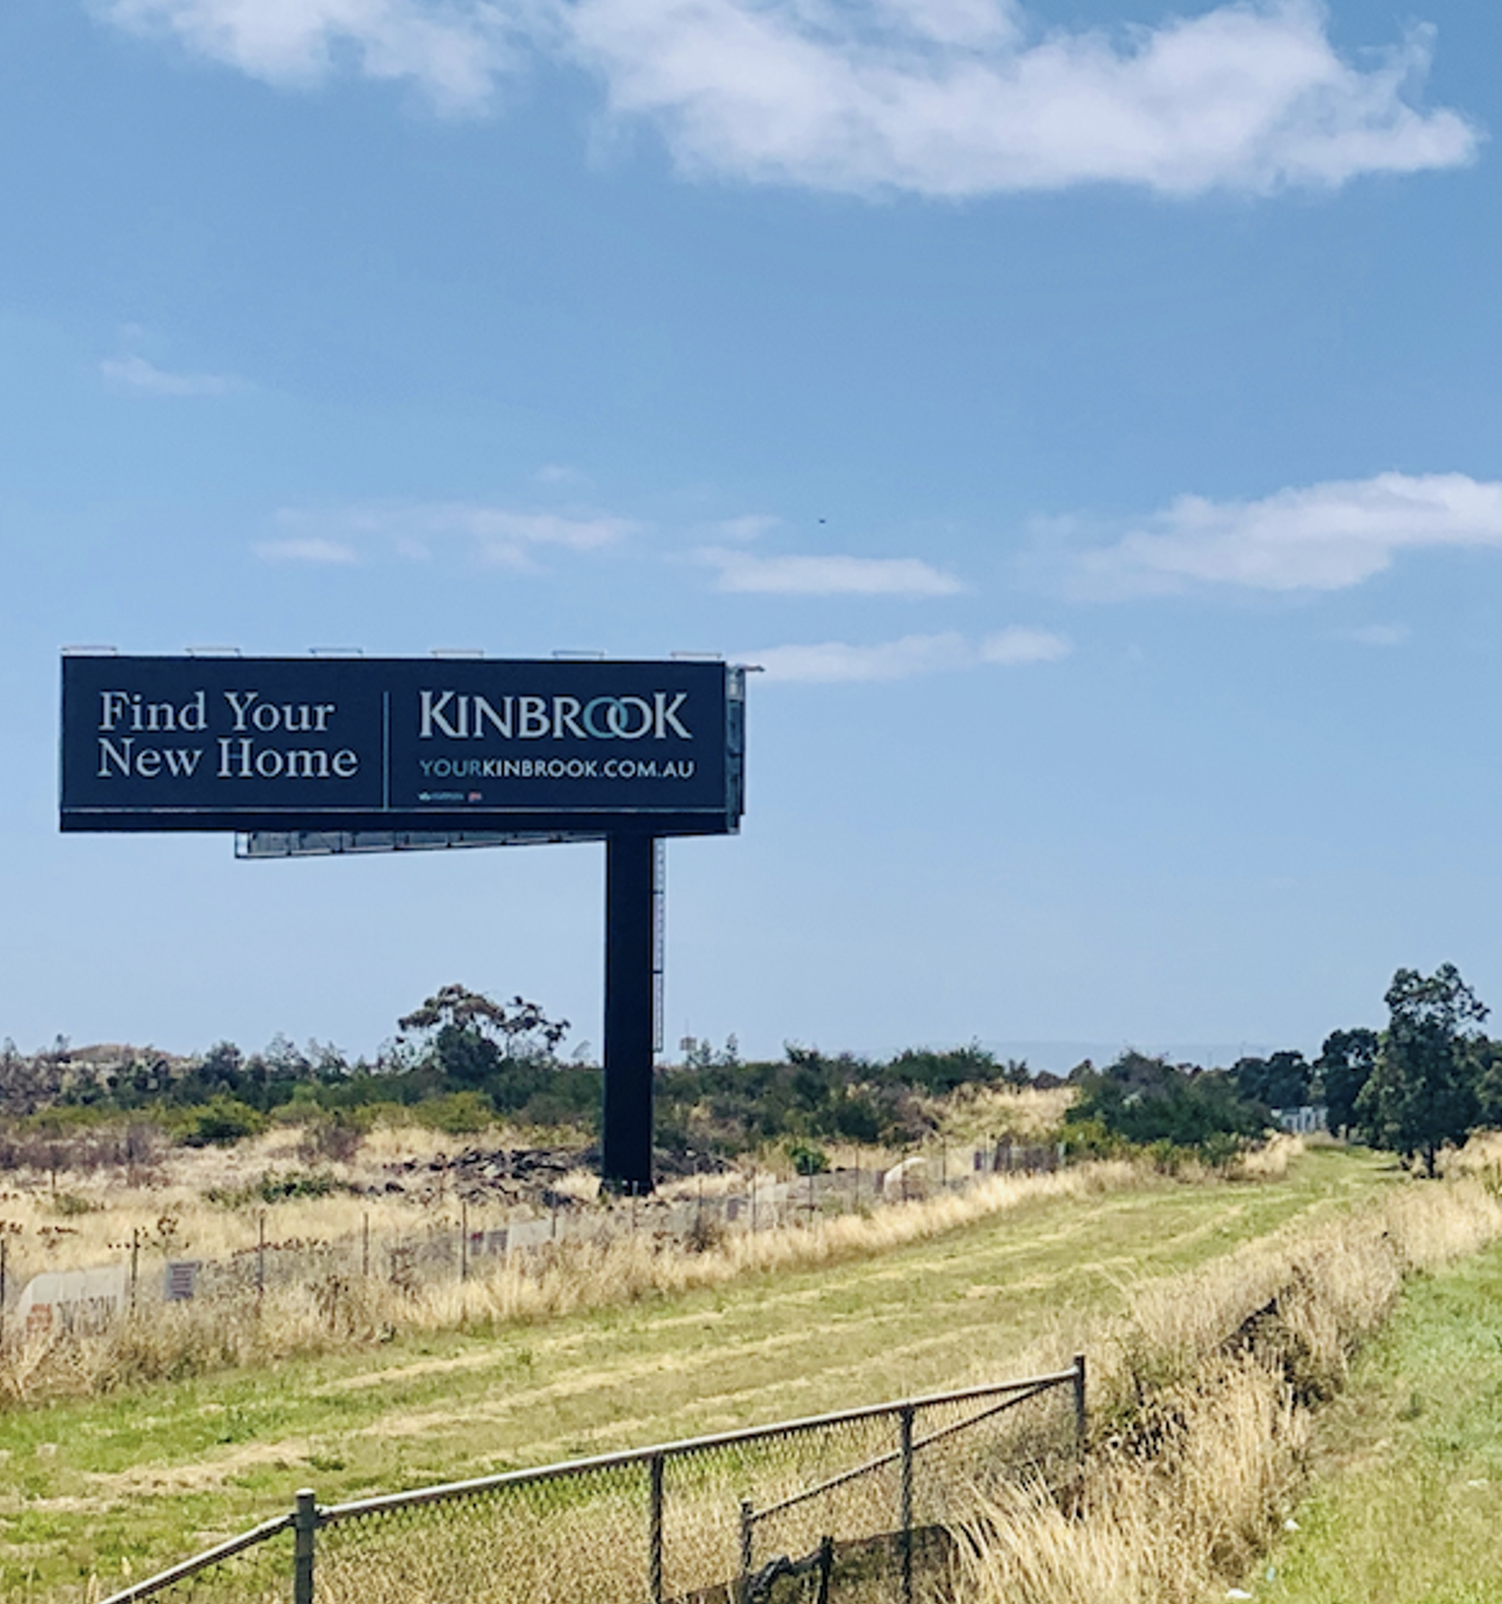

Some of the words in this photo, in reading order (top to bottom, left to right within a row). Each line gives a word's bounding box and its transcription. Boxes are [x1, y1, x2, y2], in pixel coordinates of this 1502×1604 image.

[98, 690, 208, 731] Find
[223, 691, 336, 733] Your
[419, 690, 694, 739] KINBROOK
[97, 737, 203, 778] New
[216, 738, 359, 778] Home
[419, 758, 695, 779] YOURKINBROOK.COM.AU
